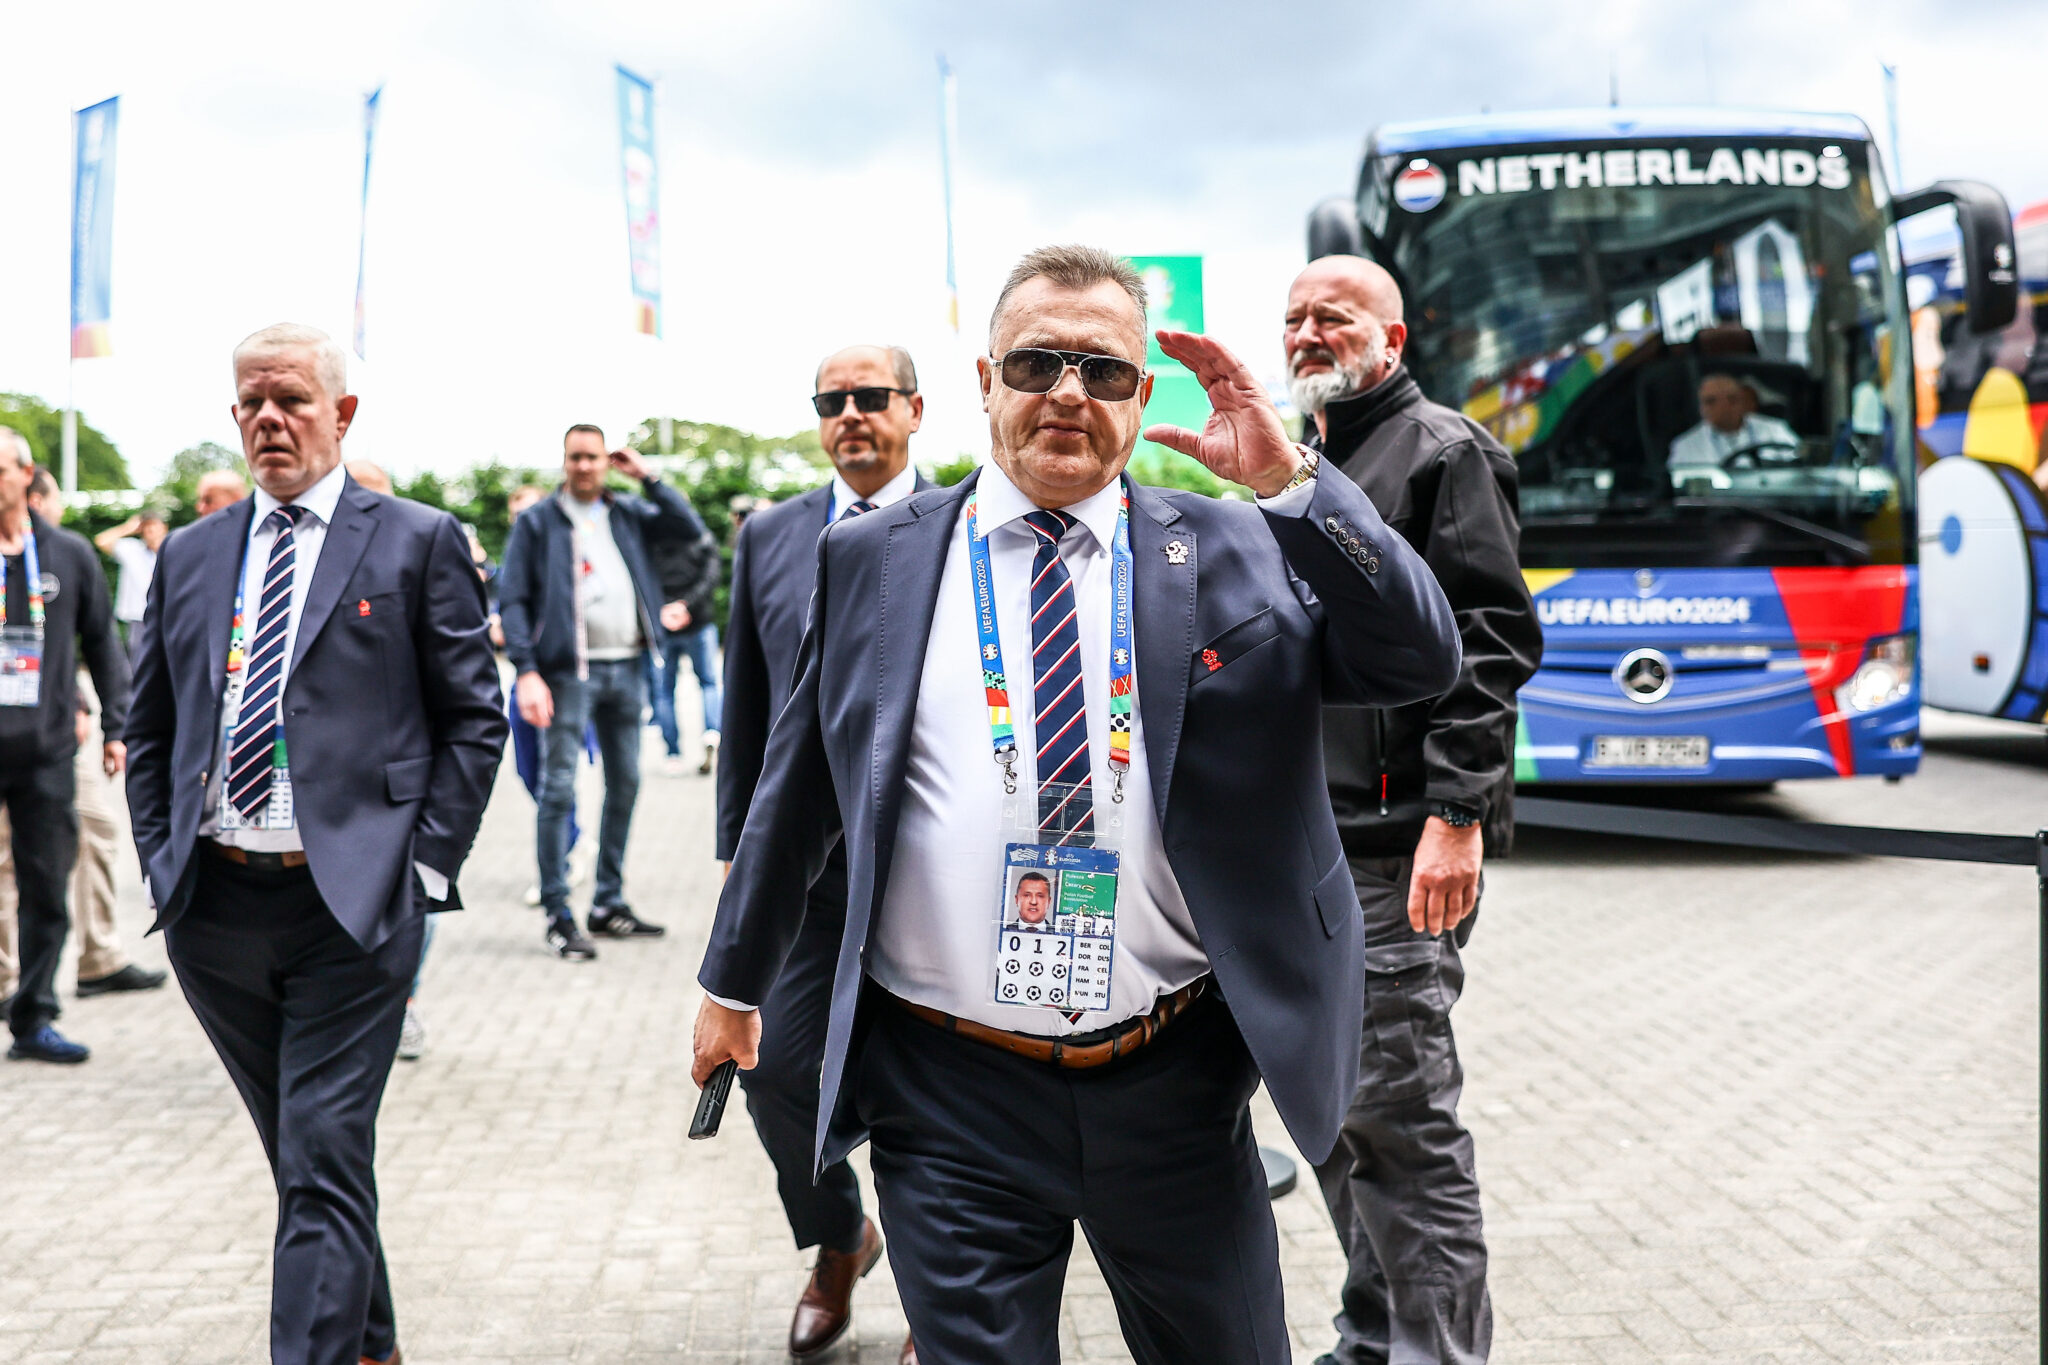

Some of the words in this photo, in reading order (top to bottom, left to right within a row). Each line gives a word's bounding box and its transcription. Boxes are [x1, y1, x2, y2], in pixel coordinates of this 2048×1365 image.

[1457, 148, 1851, 194] NETHERLANDS
[976, 559, 993, 634] UEFAEURO2024
[1117, 560, 1127, 637] UEFAEURO2024
[1537, 597, 1751, 625] UEFAEURO2024
[1009, 936, 1021, 952] 0
[1033, 938, 1043, 954] 1
[1055, 940, 1067, 956] 2
